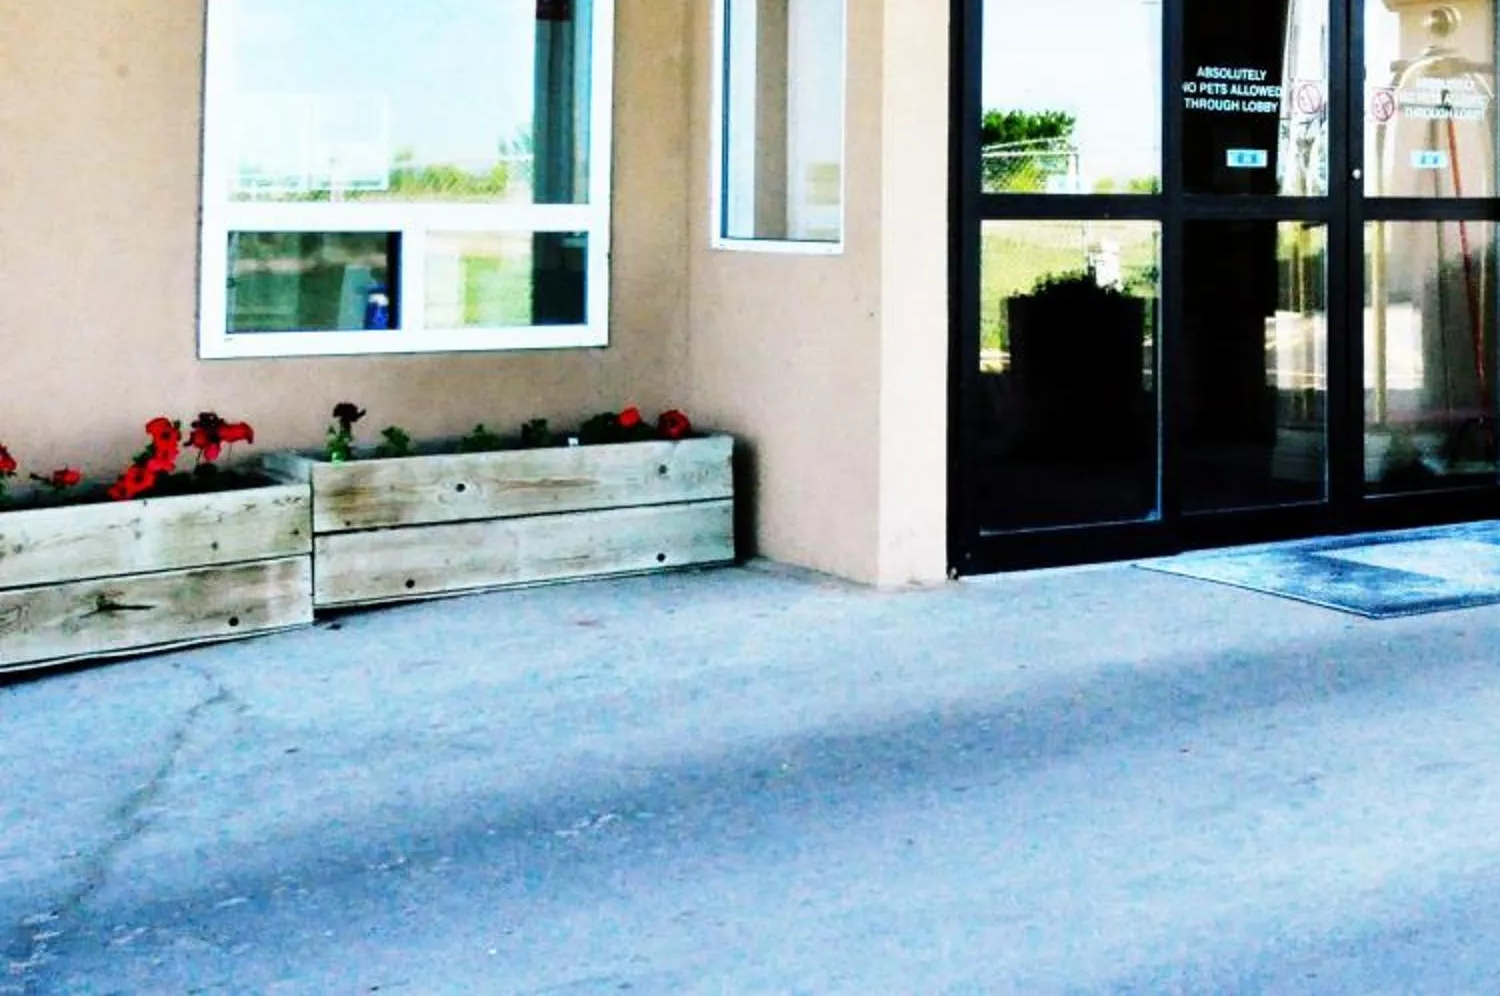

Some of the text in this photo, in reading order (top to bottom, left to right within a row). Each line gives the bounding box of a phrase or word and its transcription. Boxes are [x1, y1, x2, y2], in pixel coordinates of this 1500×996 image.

[1196, 66, 1267, 80] ABSOLUTELY
[1200, 83, 1227, 95] PETS
[1230, 84, 1282, 97] ALLOWED
[1184, 98, 1278, 113] THROUGH LOBBY
